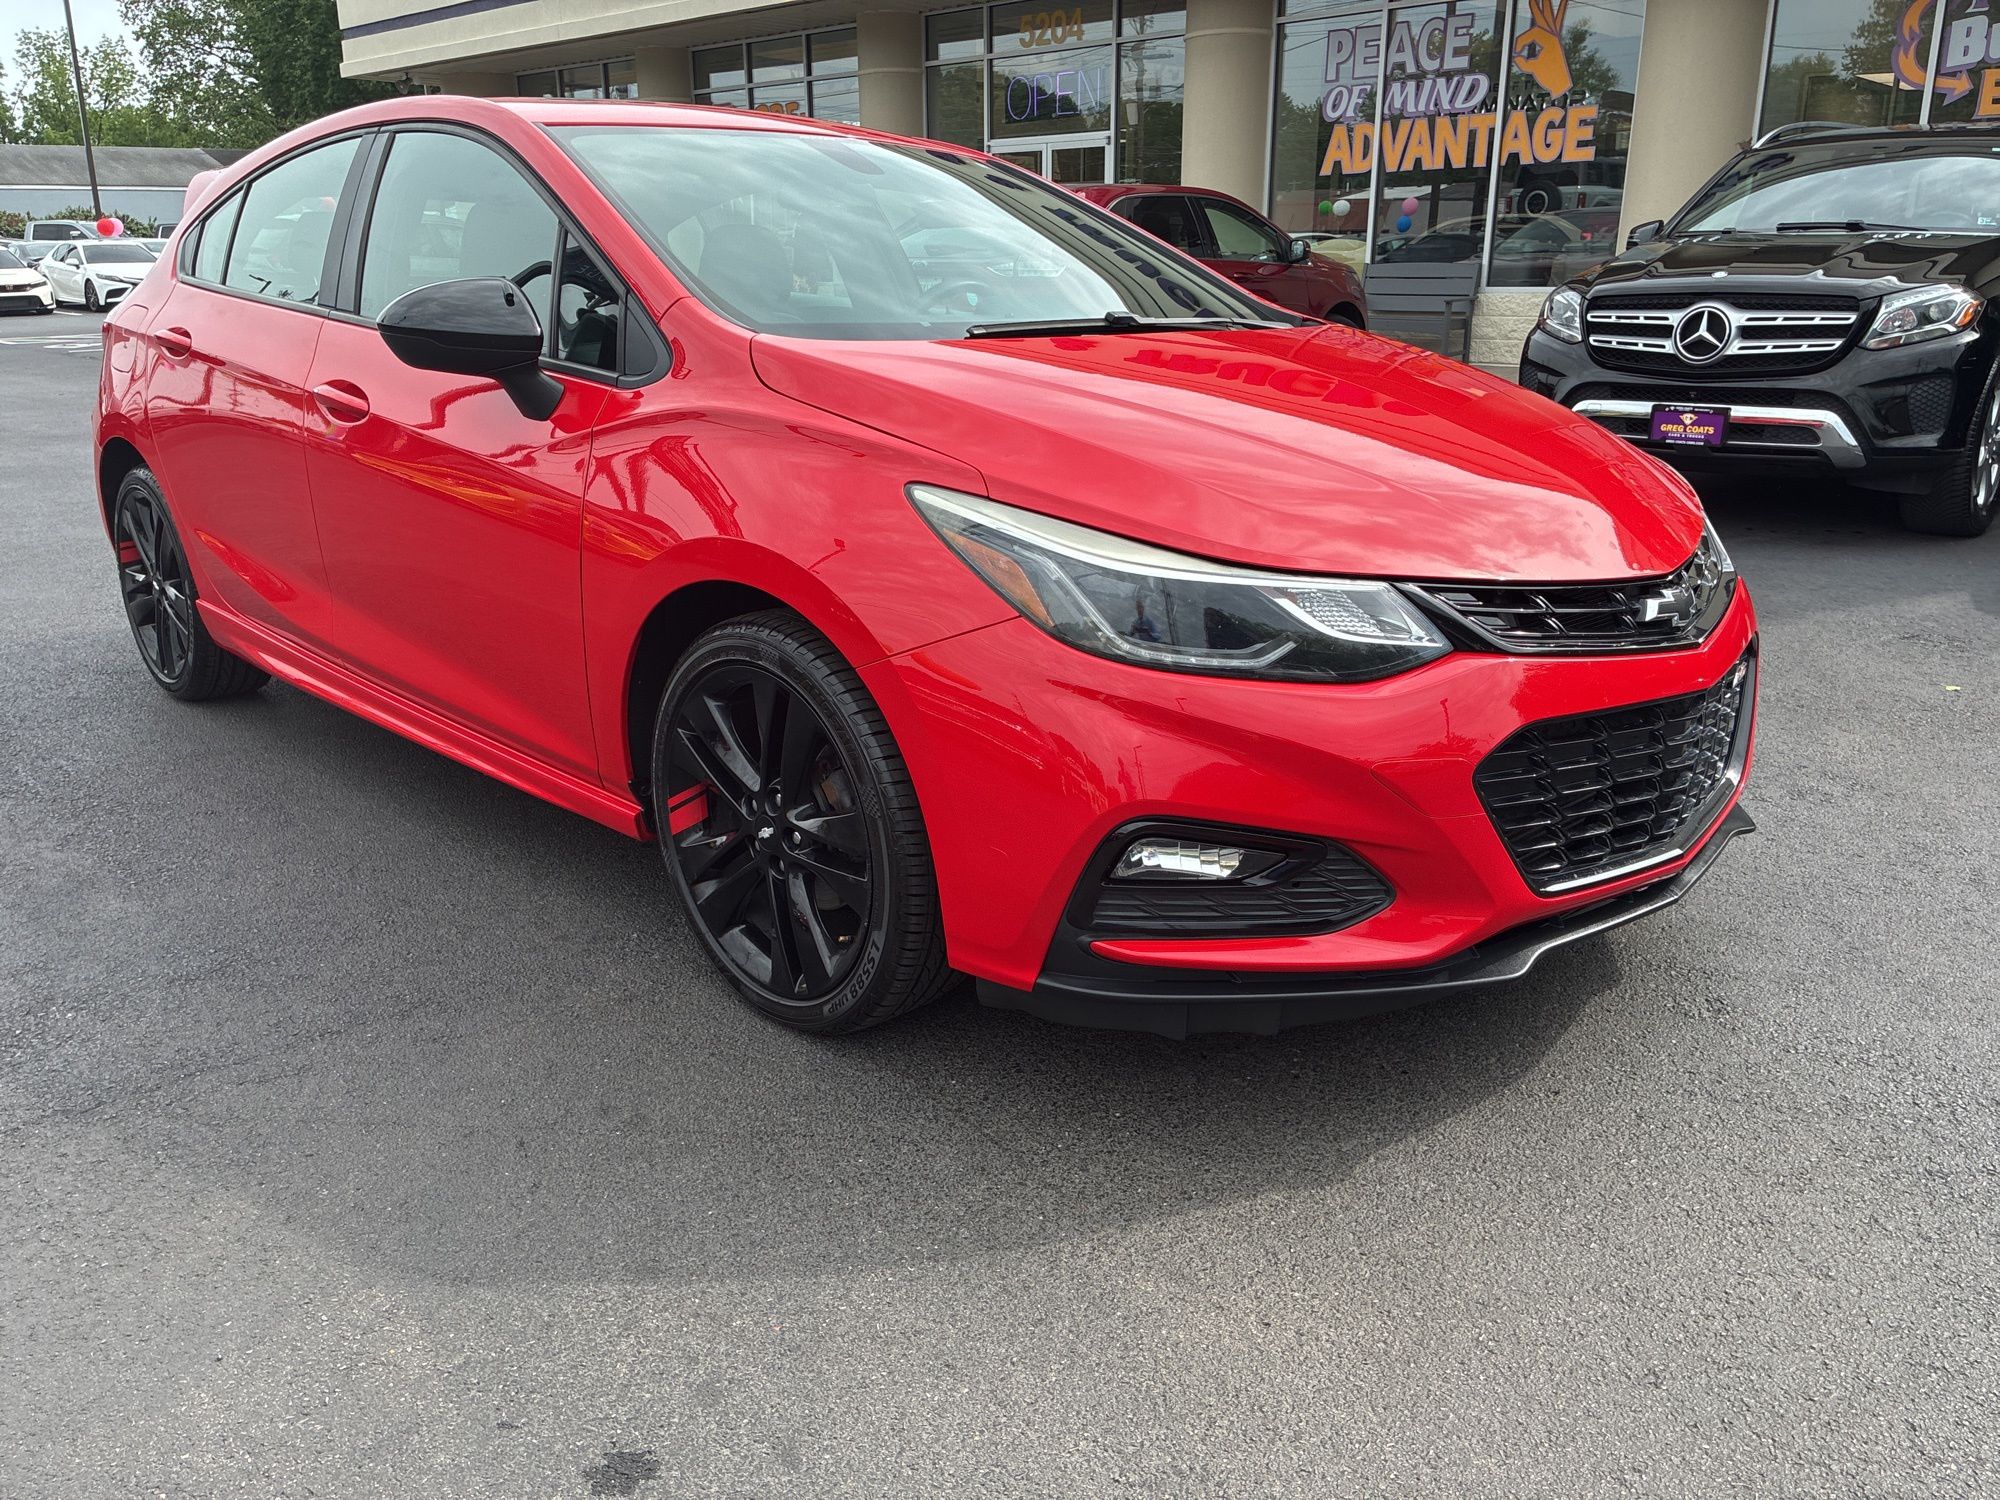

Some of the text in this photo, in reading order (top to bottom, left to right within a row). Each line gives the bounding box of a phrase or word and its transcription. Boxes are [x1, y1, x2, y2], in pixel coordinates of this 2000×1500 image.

[1019, 8, 1085, 48] 5204
[1325, 13, 1475, 83] PEACE
[1007, 67, 1101, 120] OPEN
[1323, 84, 1372, 122] OF
[1383, 73, 1490, 117] MIND
[1319, 104, 1599, 177] ADVANTAGE
[1660, 424, 1715, 434] GREG COATS
